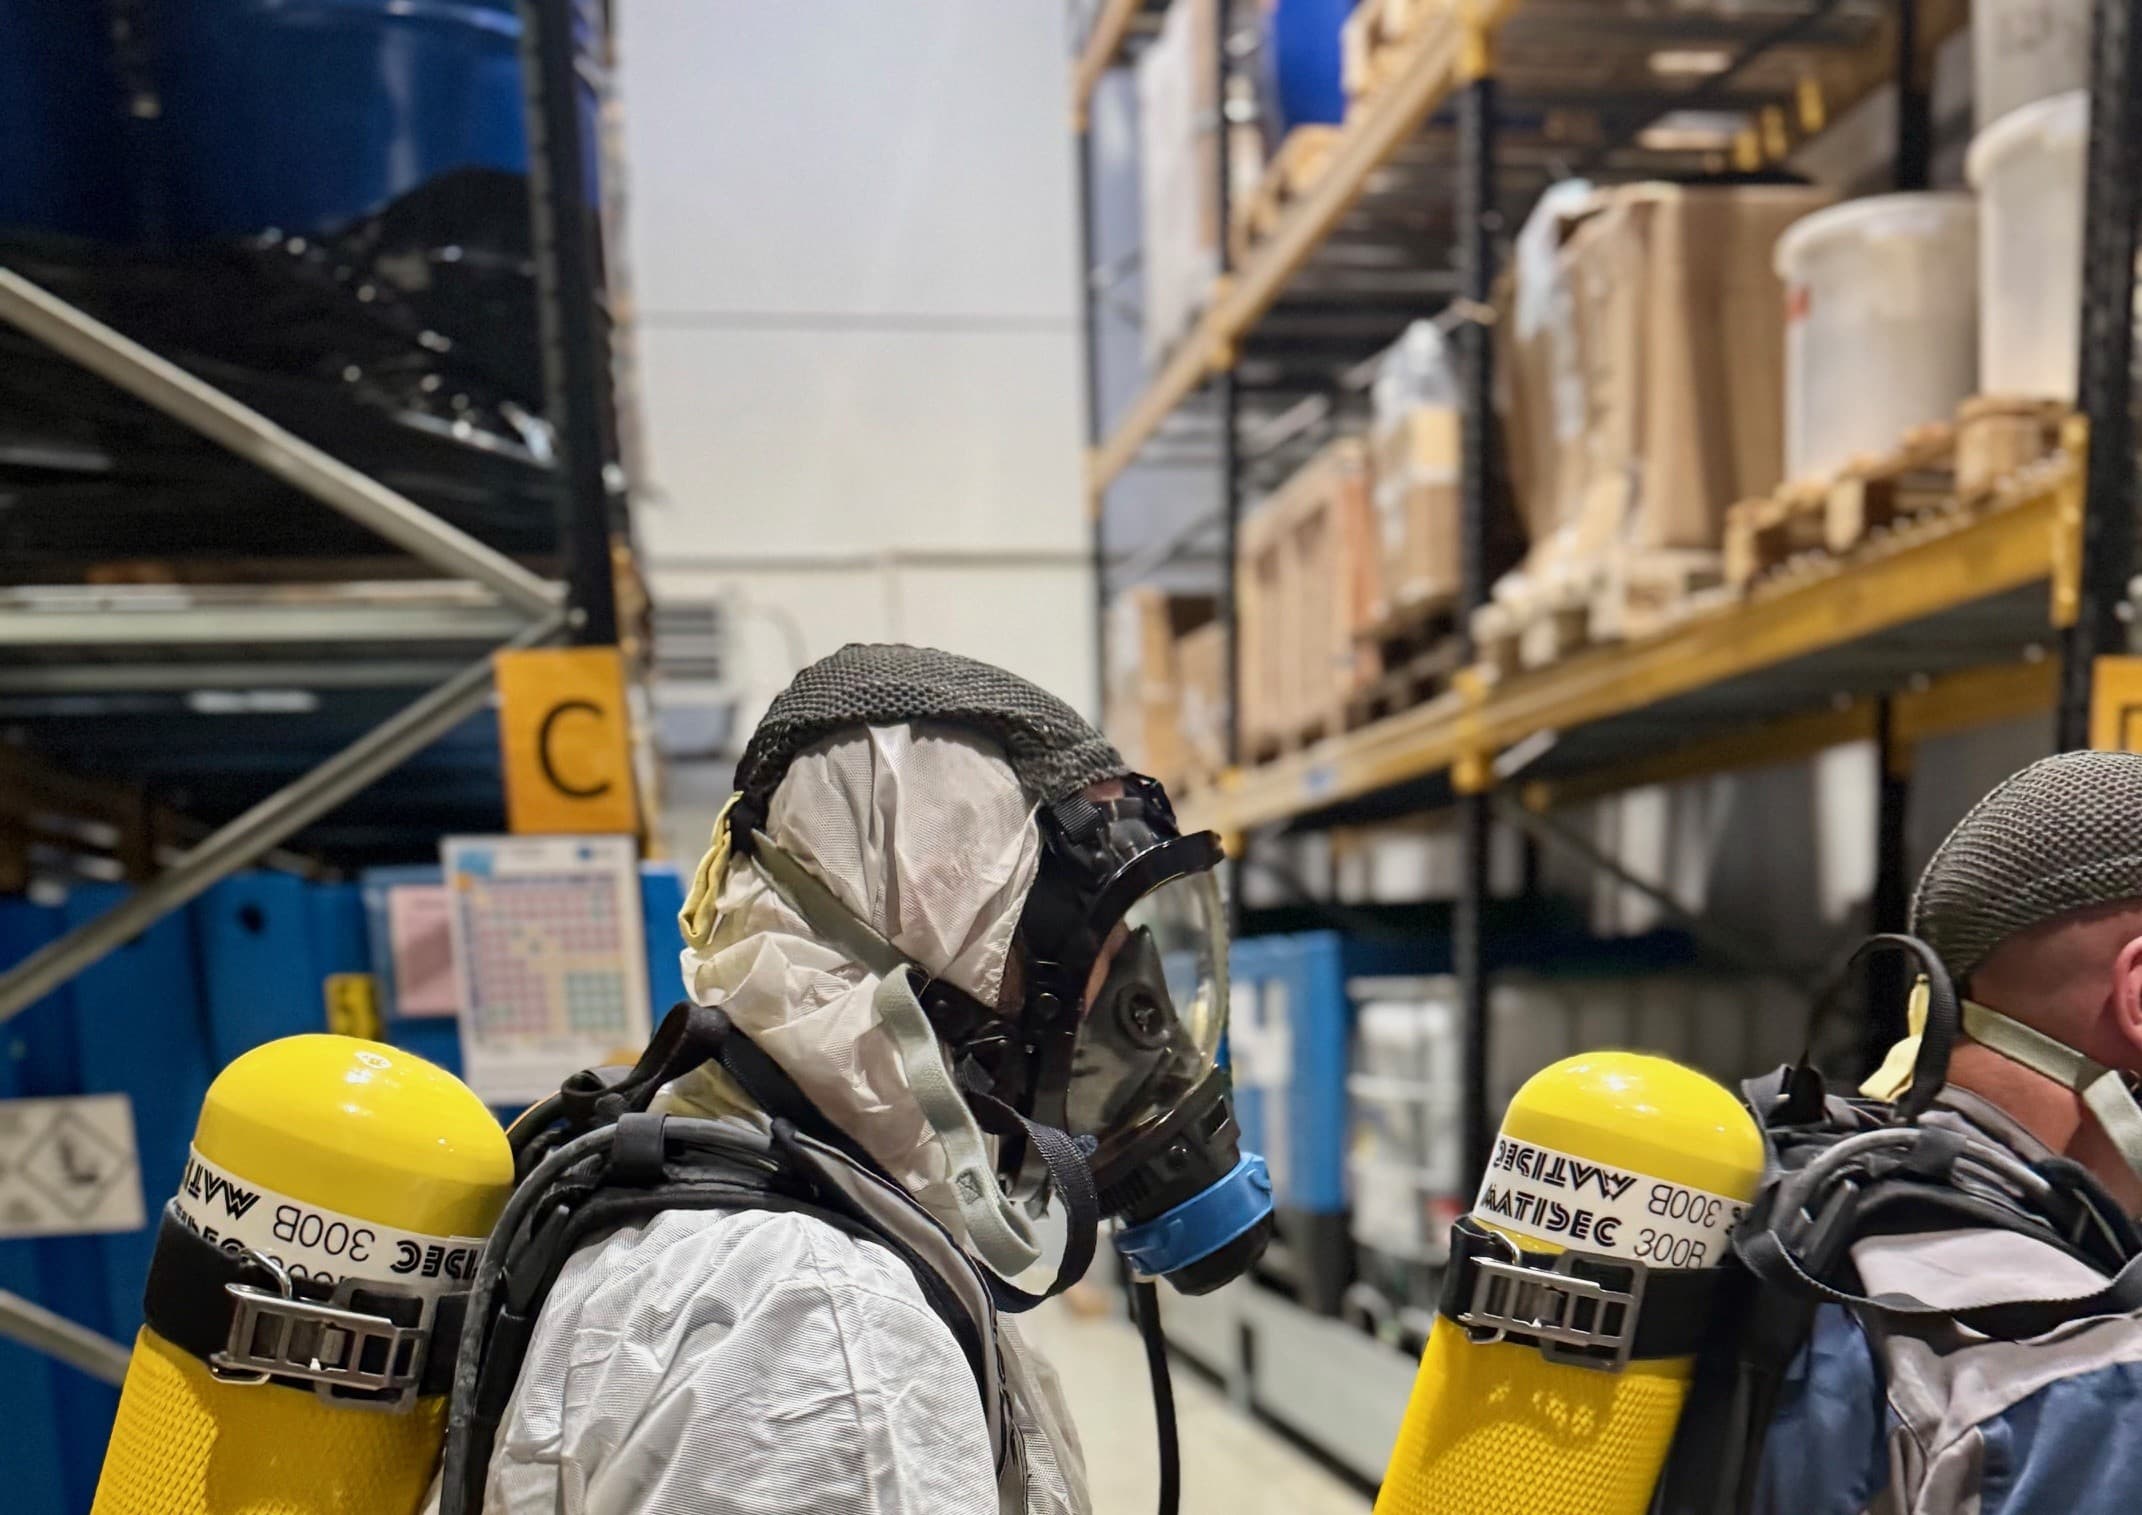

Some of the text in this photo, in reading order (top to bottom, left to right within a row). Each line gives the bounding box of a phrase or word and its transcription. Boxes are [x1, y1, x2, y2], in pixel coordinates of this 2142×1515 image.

[537, 699, 613, 799] C
[1493, 1139, 1638, 1202] MATISEC
[272, 1204, 376, 1263] 300B
[1480, 1183, 1623, 1248] MATISEC
[1647, 1184, 1723, 1229] 300B
[389, 1239, 479, 1281] ISEC
